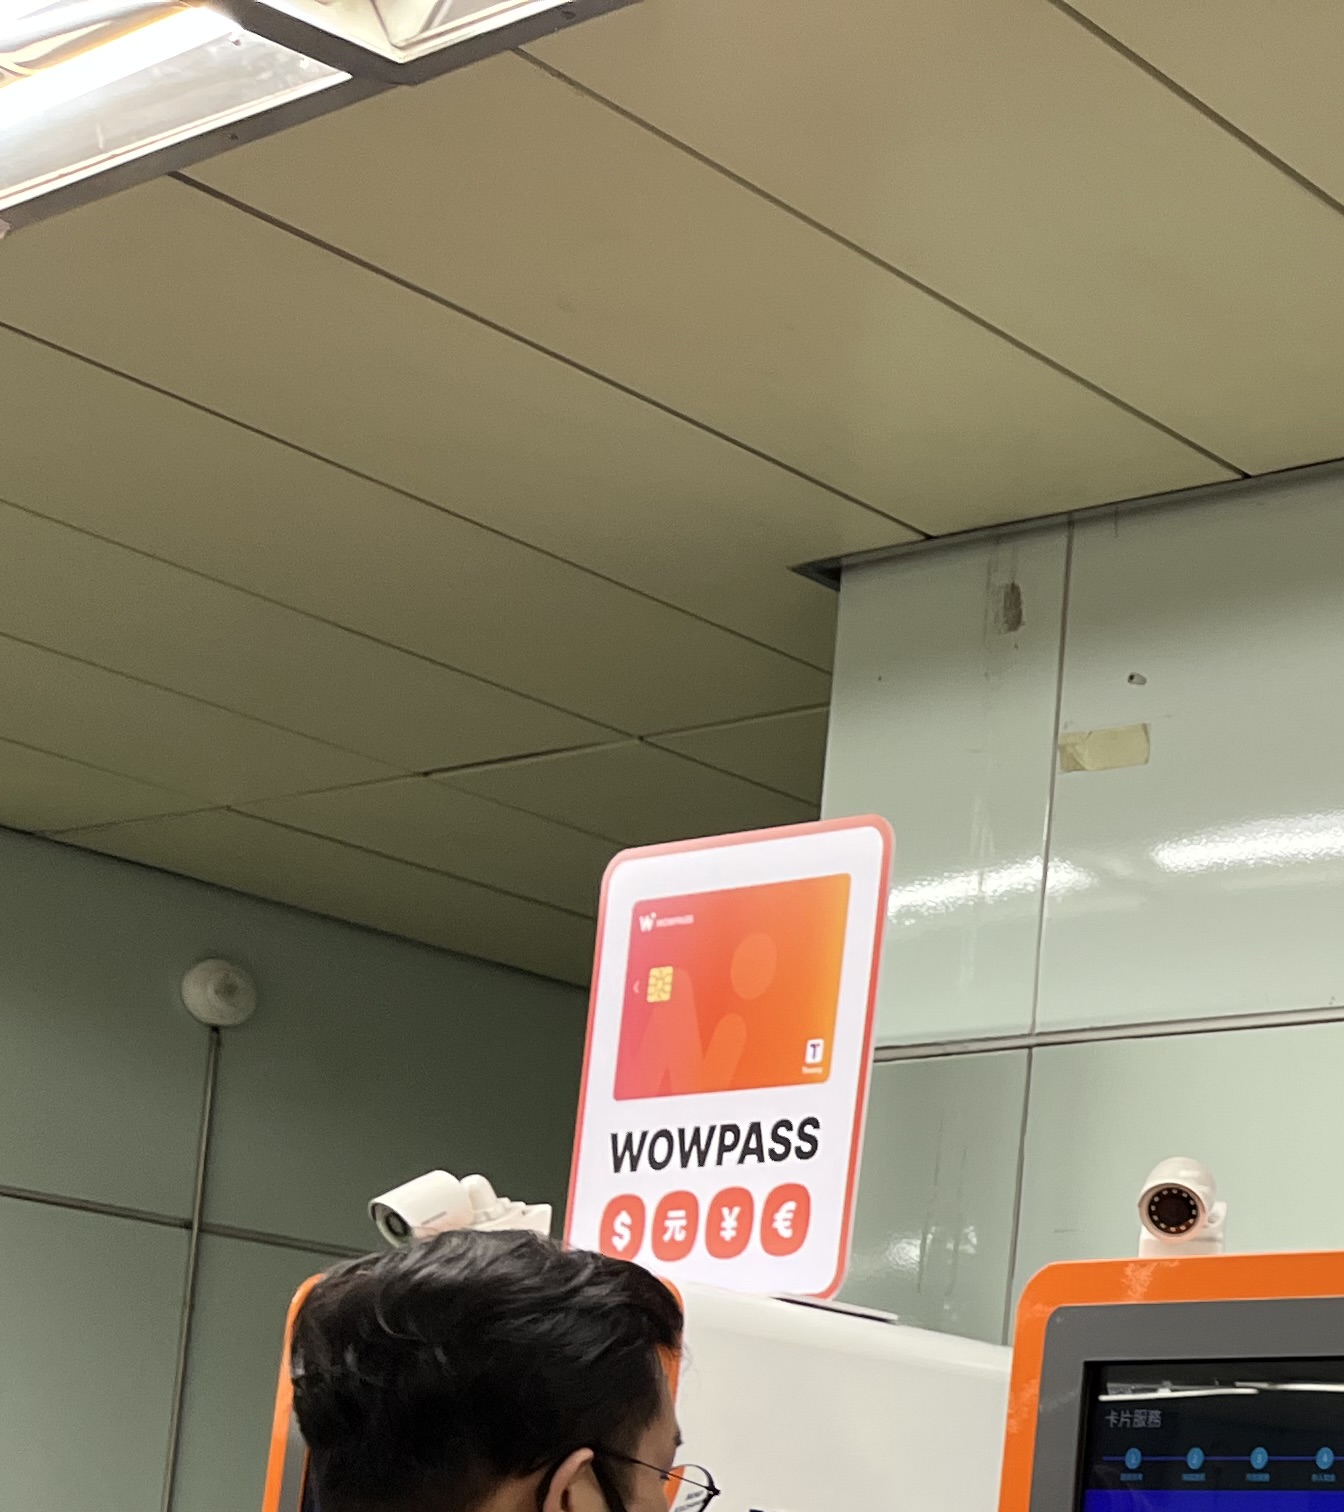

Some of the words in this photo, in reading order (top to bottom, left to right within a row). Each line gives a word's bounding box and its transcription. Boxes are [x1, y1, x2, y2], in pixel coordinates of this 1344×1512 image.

[610, 1116, 821, 1173] WOWPASS
[611, 1210, 633, 1251] $
[662, 1210, 688, 1242] 元
[720, 1207, 740, 1241] ¥
[773, 1201, 797, 1238] €
